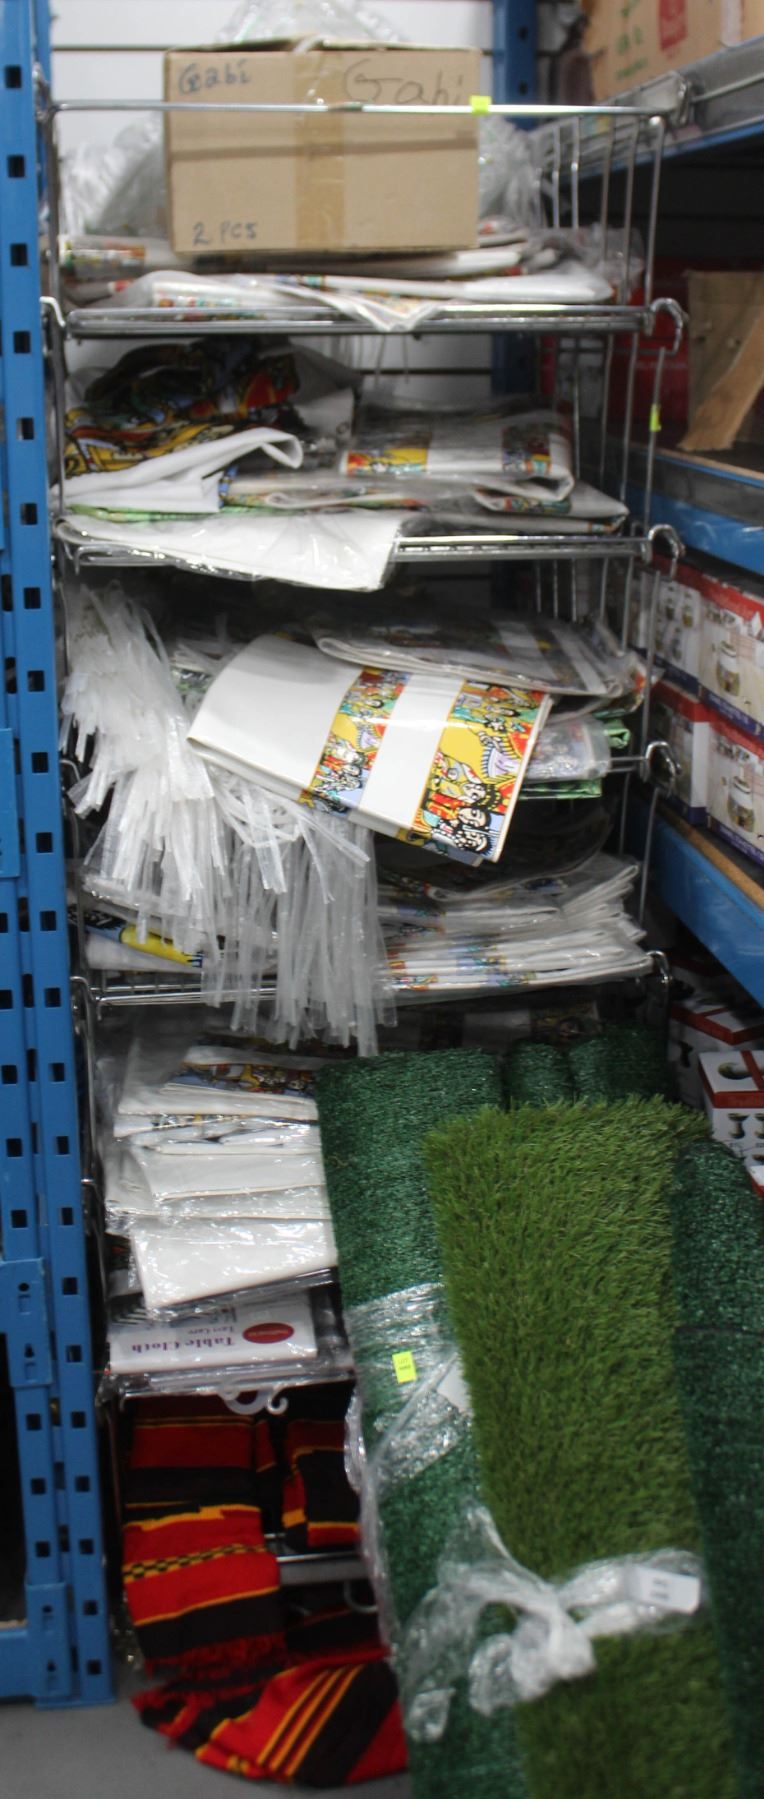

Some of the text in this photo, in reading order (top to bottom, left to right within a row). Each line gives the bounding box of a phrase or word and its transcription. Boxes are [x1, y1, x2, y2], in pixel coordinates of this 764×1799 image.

[179, 59, 251, 95] Gabi
[193, 222, 210, 245] 2
[132, 1337, 235, 1353] Table Cloth
